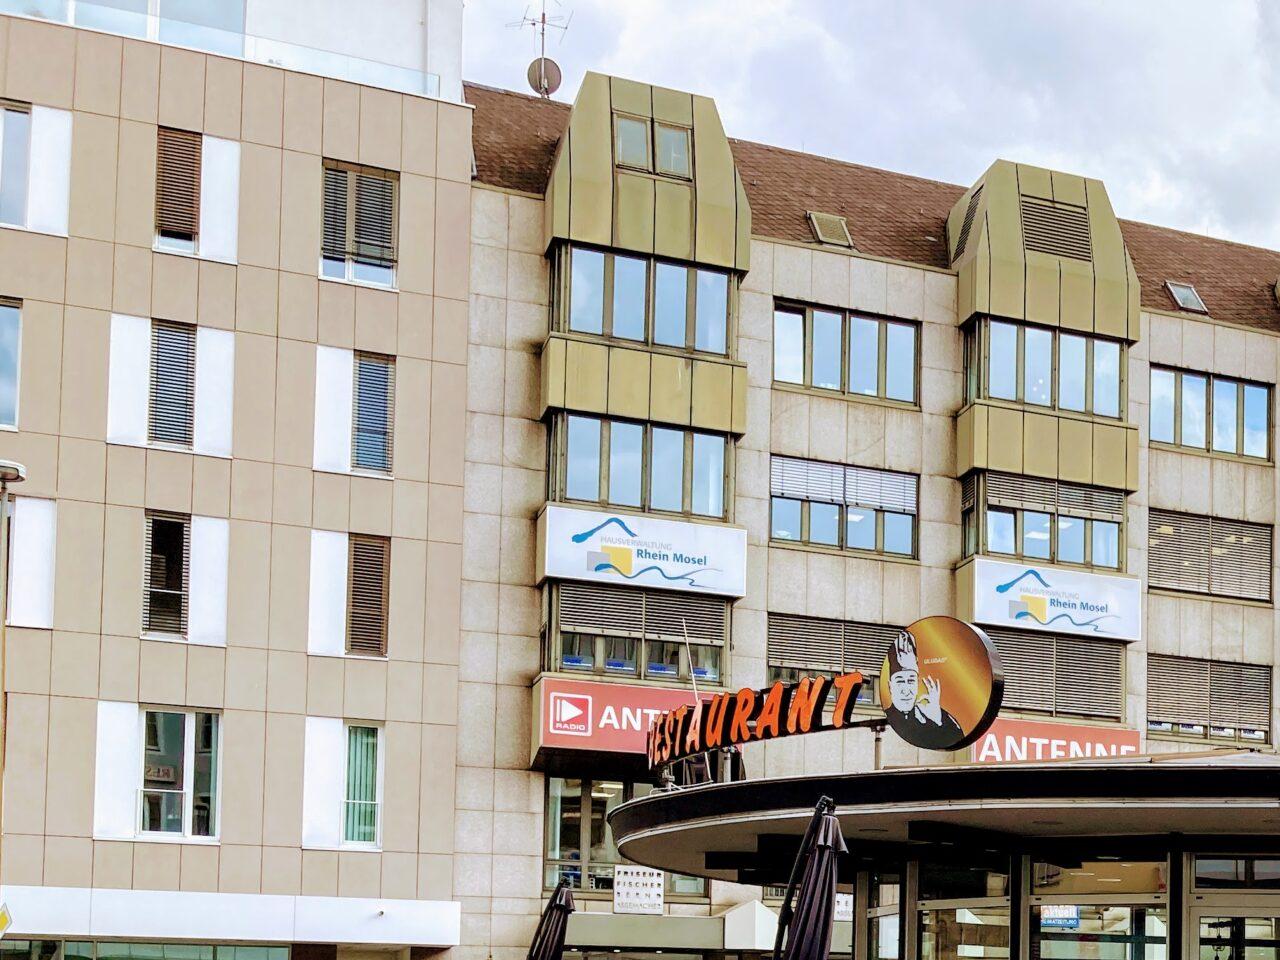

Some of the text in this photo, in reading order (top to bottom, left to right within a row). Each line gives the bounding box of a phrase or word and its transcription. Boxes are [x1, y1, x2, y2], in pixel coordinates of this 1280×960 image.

[600, 535, 673, 551] HAUSVERWALTUNG
[636, 549, 707, 566] Rhein Mosel
[1050, 598, 1108, 613] Rhein Mosel
[598, 705, 670, 731] ANT
[646, 671, 863, 771] RESTAURANT
[555, 722, 586, 731] RADIO
